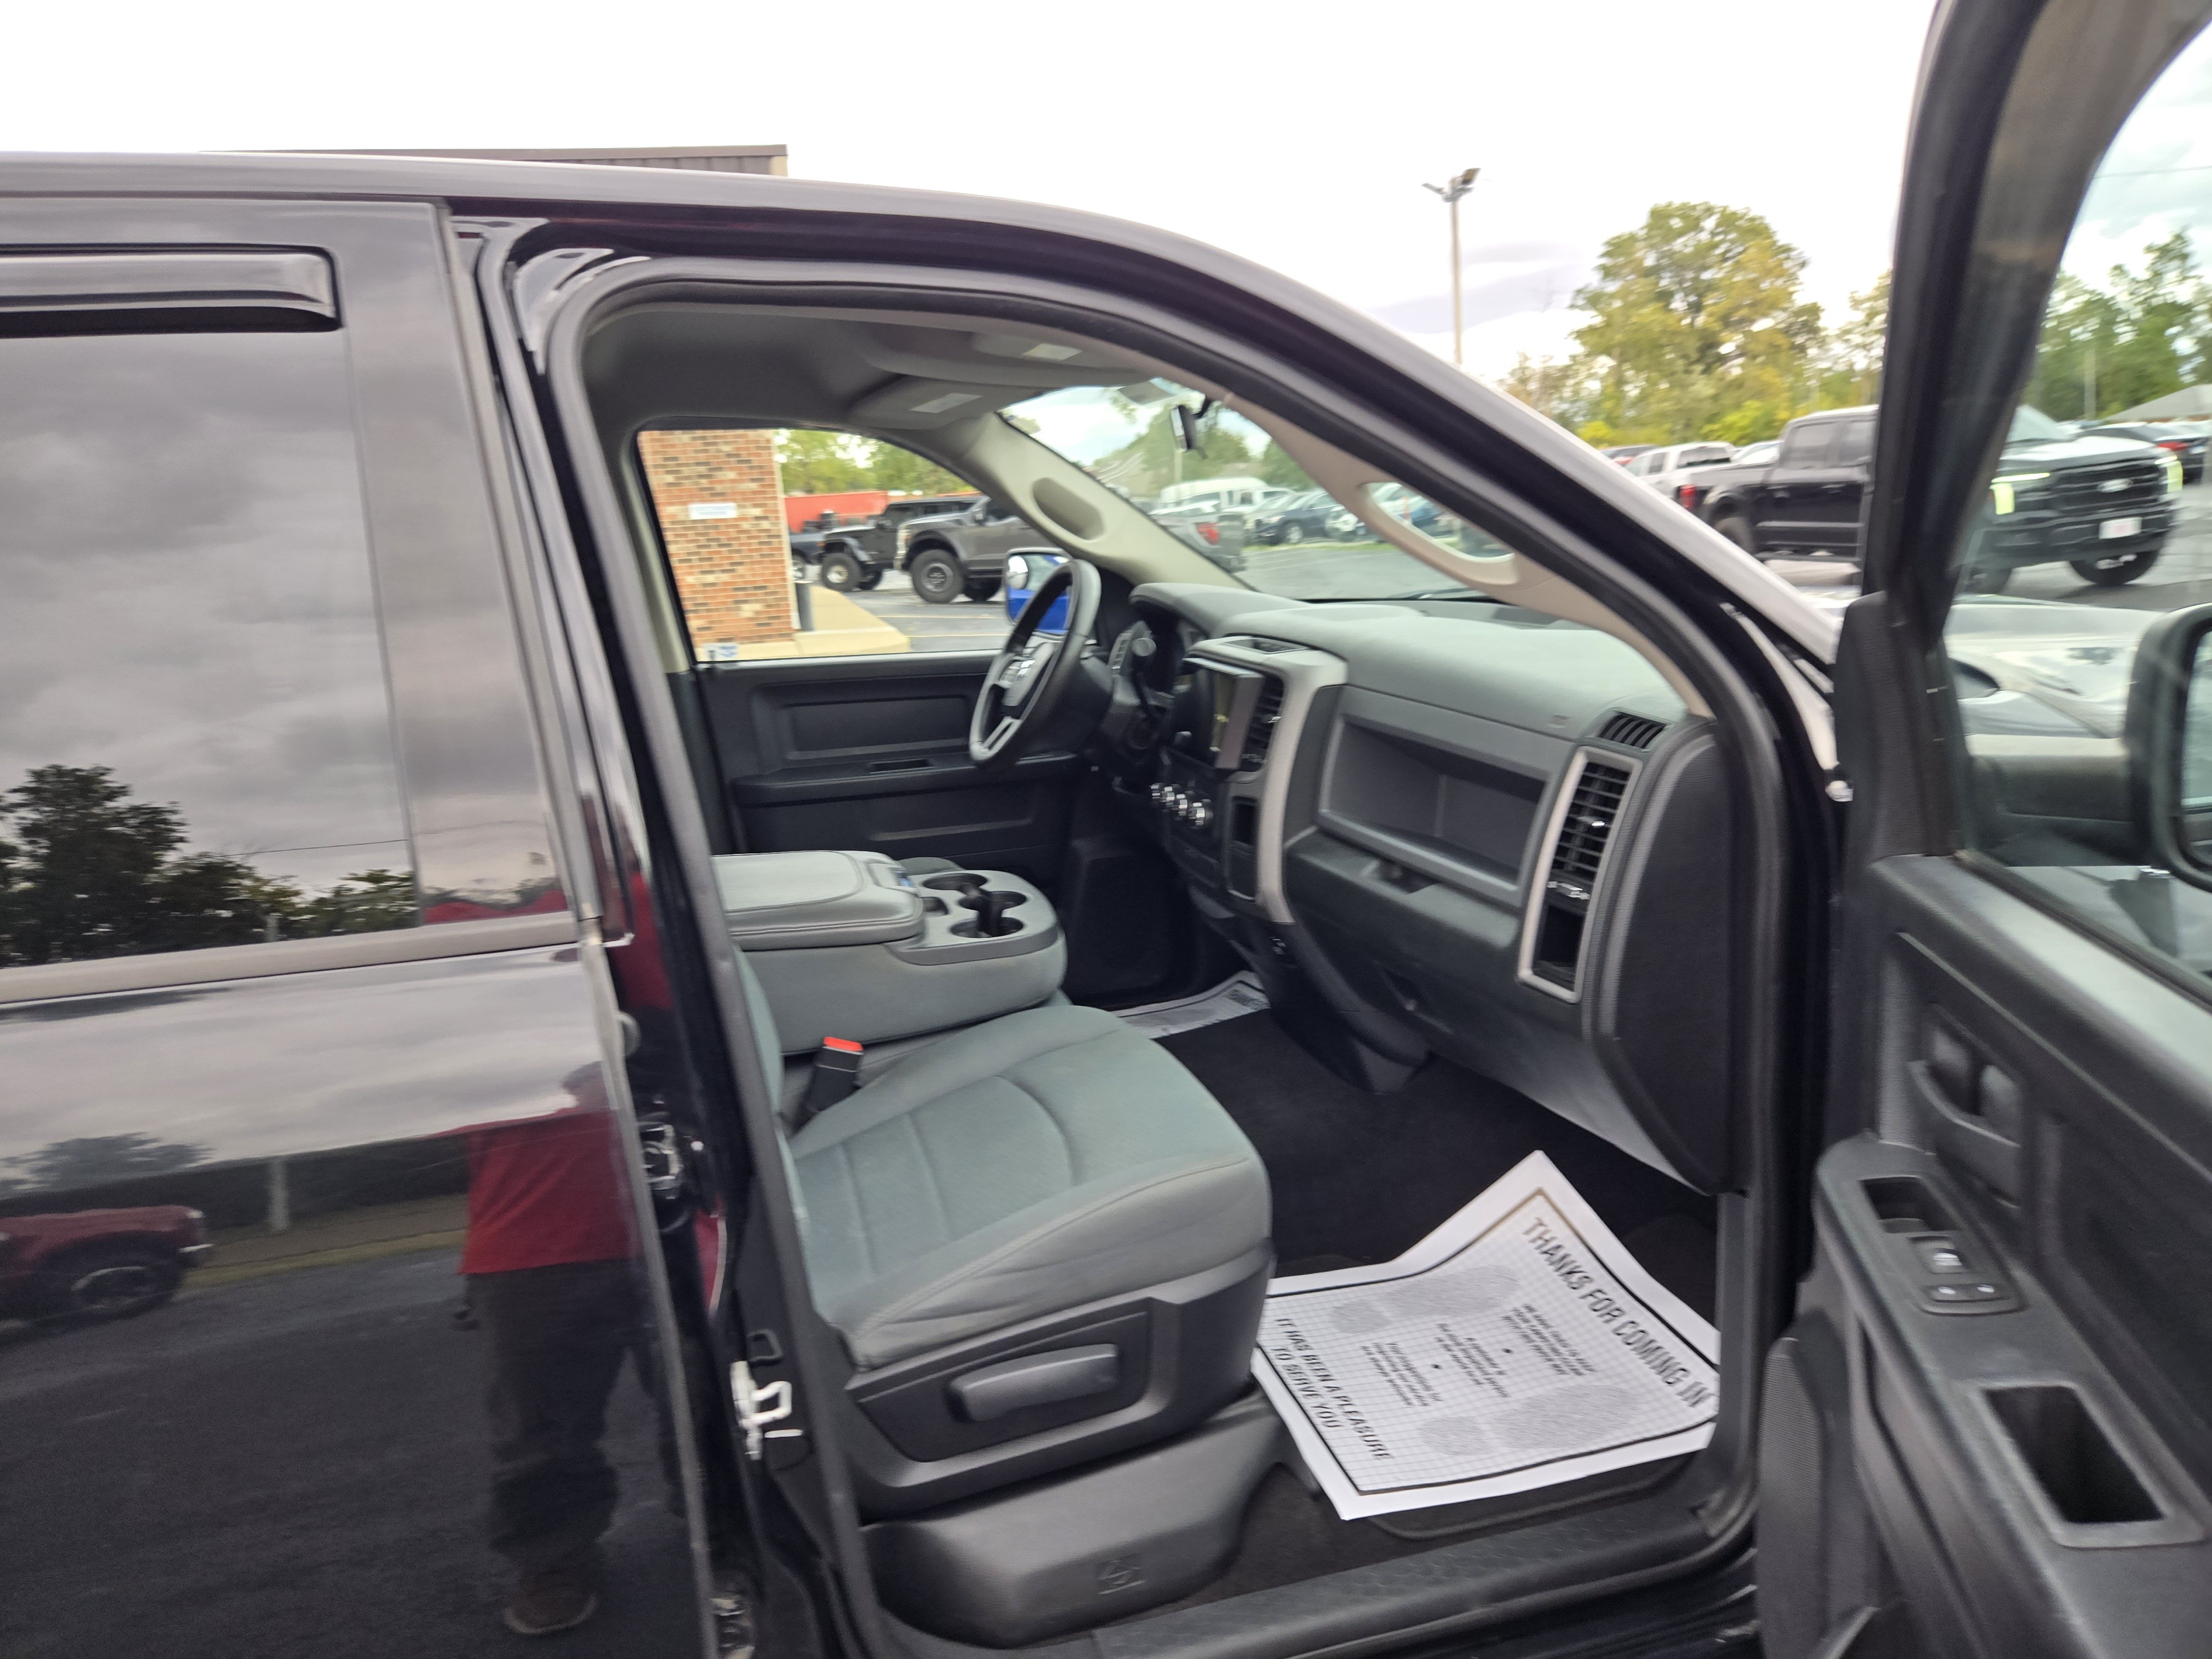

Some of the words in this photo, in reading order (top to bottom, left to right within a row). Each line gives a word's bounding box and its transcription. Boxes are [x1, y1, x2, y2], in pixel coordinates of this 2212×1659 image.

[1274, 1318, 1296, 1326] IT
[1522, 1217, 1594, 1291] THANKS
[1578, 1288, 1626, 1324] FOR
[1610, 1320, 1691, 1385] COMING
[1675, 1381, 1714, 1408] IN
[1271, 1346, 1294, 1360] TO
[1283, 1331, 1314, 1351] HAS
[1300, 1354, 1337, 1382] BEEN
[1281, 1364, 1324, 1400] SERVE
[1311, 1402, 1344, 1428] YOU
[1331, 1395, 1394, 1460] PLEASURE
